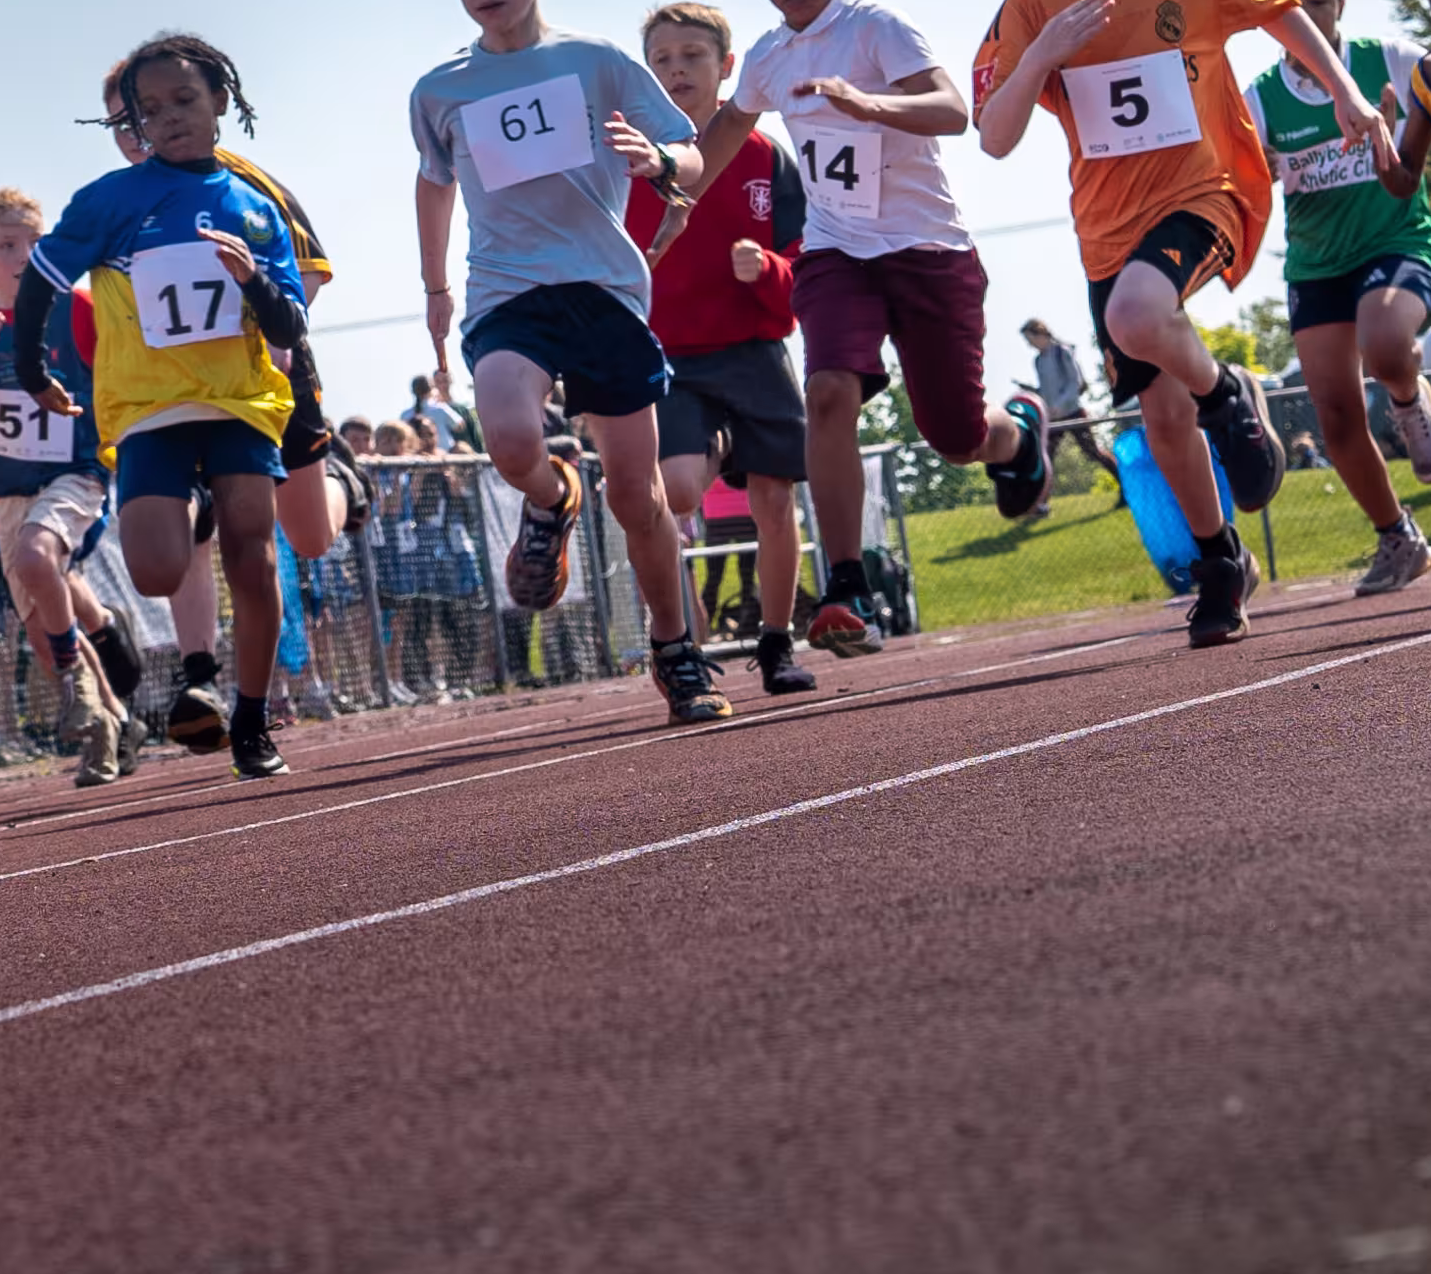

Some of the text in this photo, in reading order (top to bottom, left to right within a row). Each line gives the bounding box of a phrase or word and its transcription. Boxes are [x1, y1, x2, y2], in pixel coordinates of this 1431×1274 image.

[500, 98, 556, 142] 61
[1109, 75, 1149, 128] 5
[800, 139, 860, 192] 14
[195, 211, 214, 231] 6
[157, 279, 226, 337] 17
